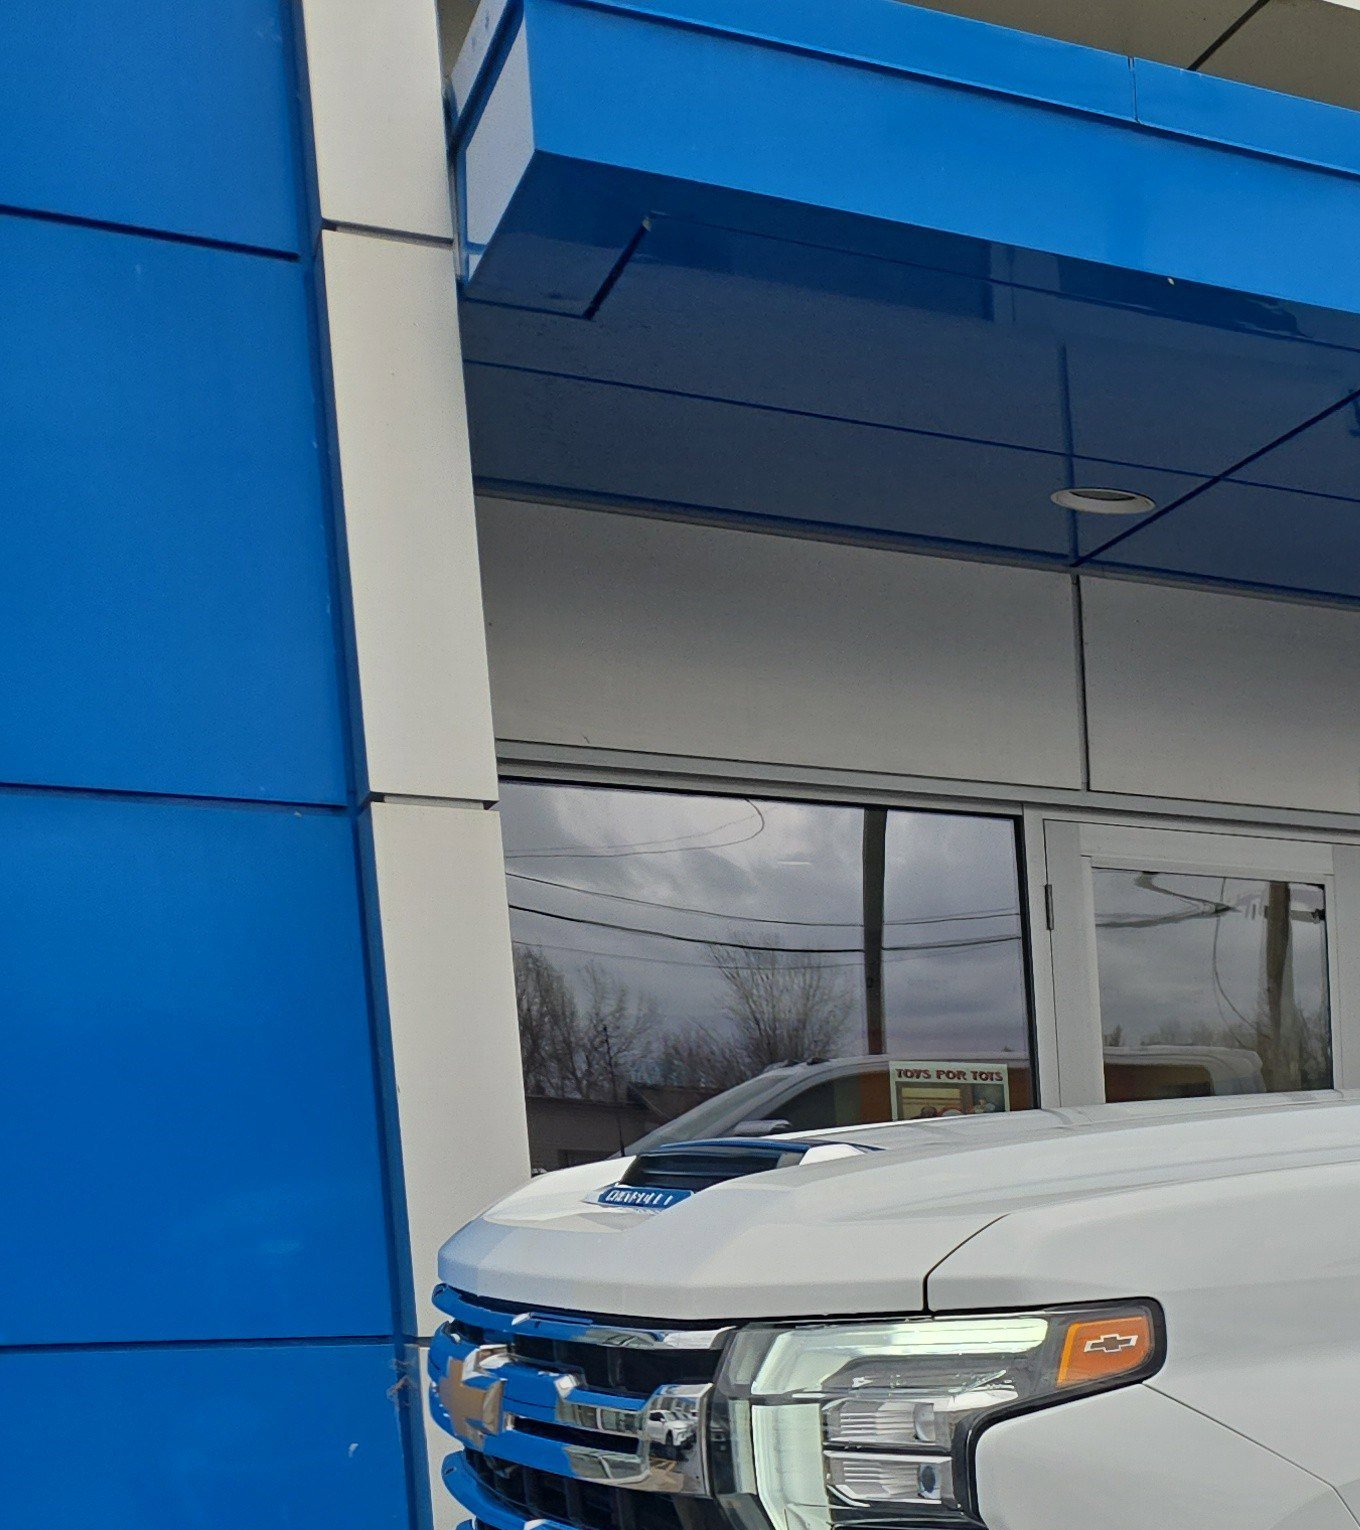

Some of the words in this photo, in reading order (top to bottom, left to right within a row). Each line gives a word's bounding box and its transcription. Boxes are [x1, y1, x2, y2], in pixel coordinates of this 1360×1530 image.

[895, 1068, 932, 1080] TOYS
[935, 1069, 968, 1081] FOR
[970, 1070, 1004, 1082] TOTS
